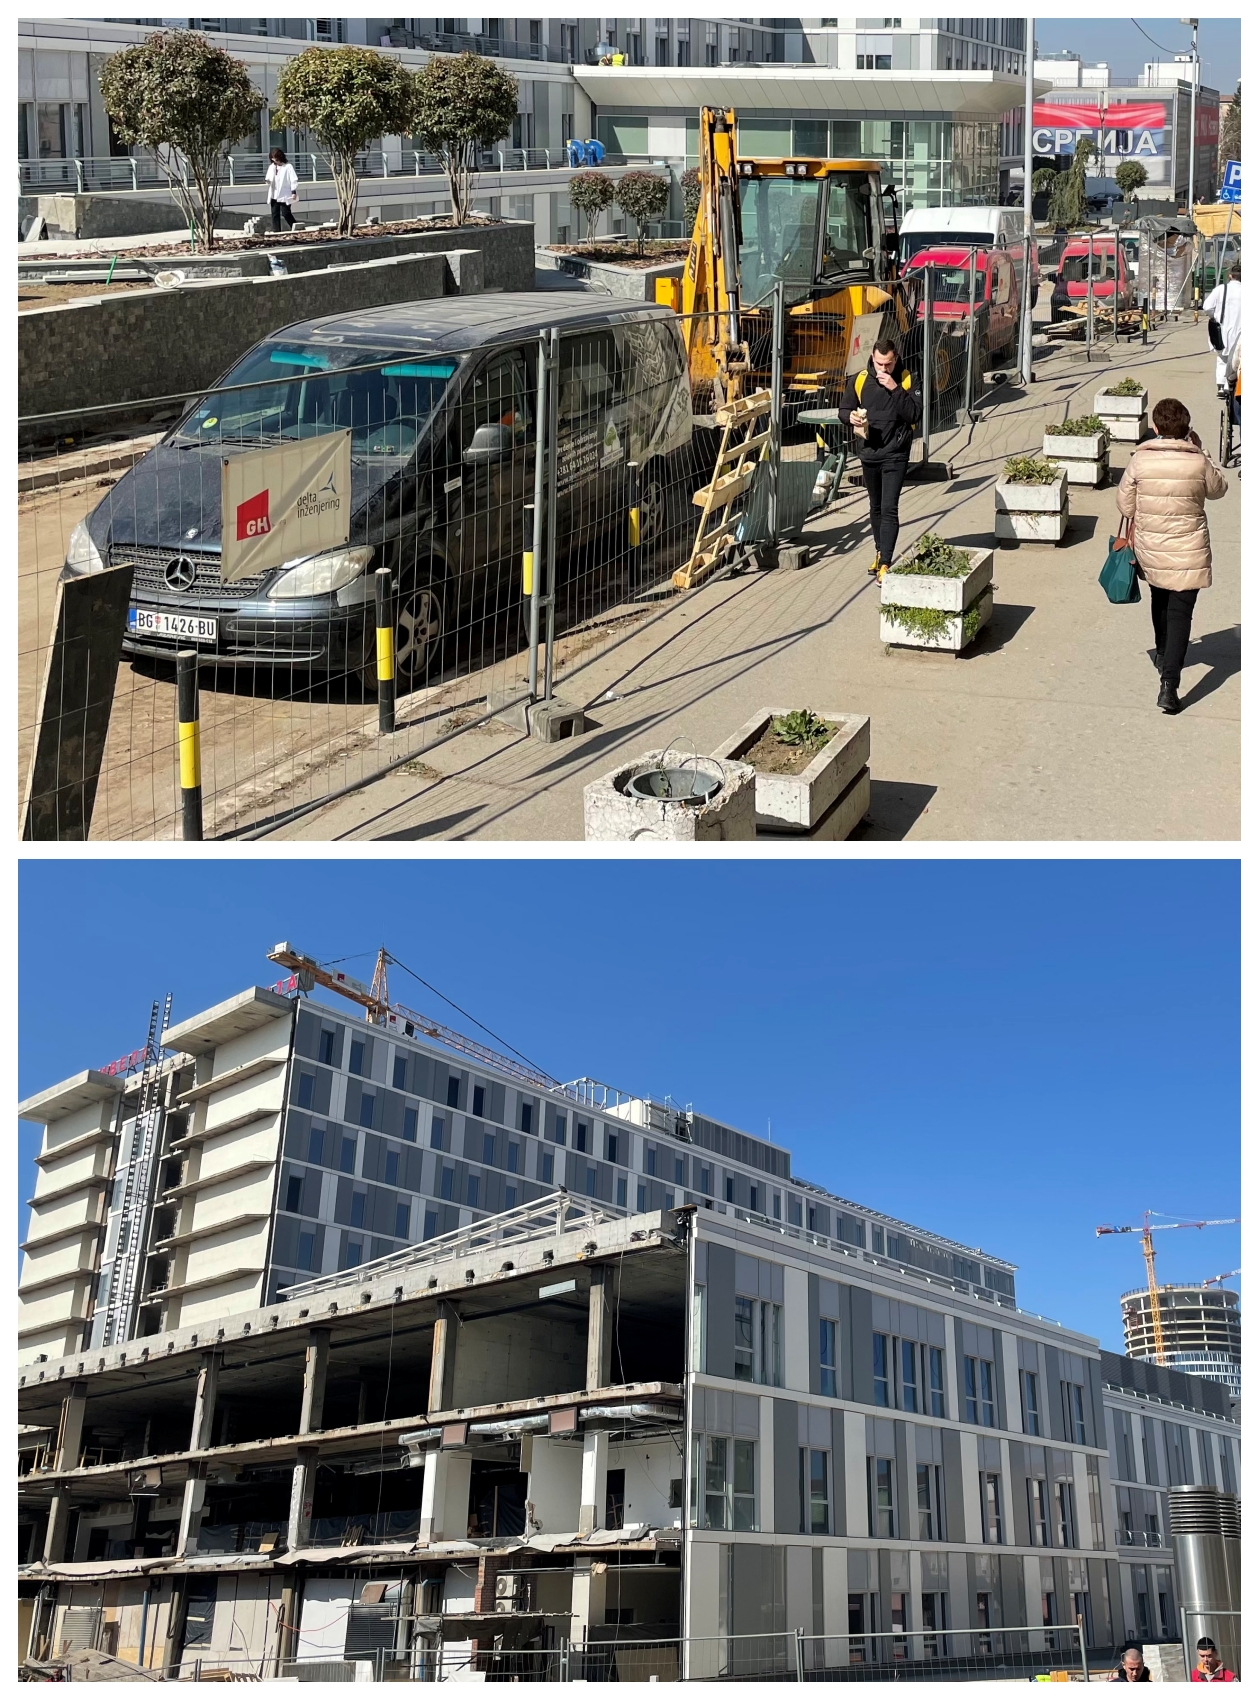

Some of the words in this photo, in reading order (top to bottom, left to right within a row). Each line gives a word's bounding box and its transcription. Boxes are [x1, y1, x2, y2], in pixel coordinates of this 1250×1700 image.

[1229, 164, 1241, 185] P
[296, 492, 317, 507] delta
[297, 497, 340, 519] inženjering
[246, 516, 269, 536] GH
[138, 612, 153, 629] BG
